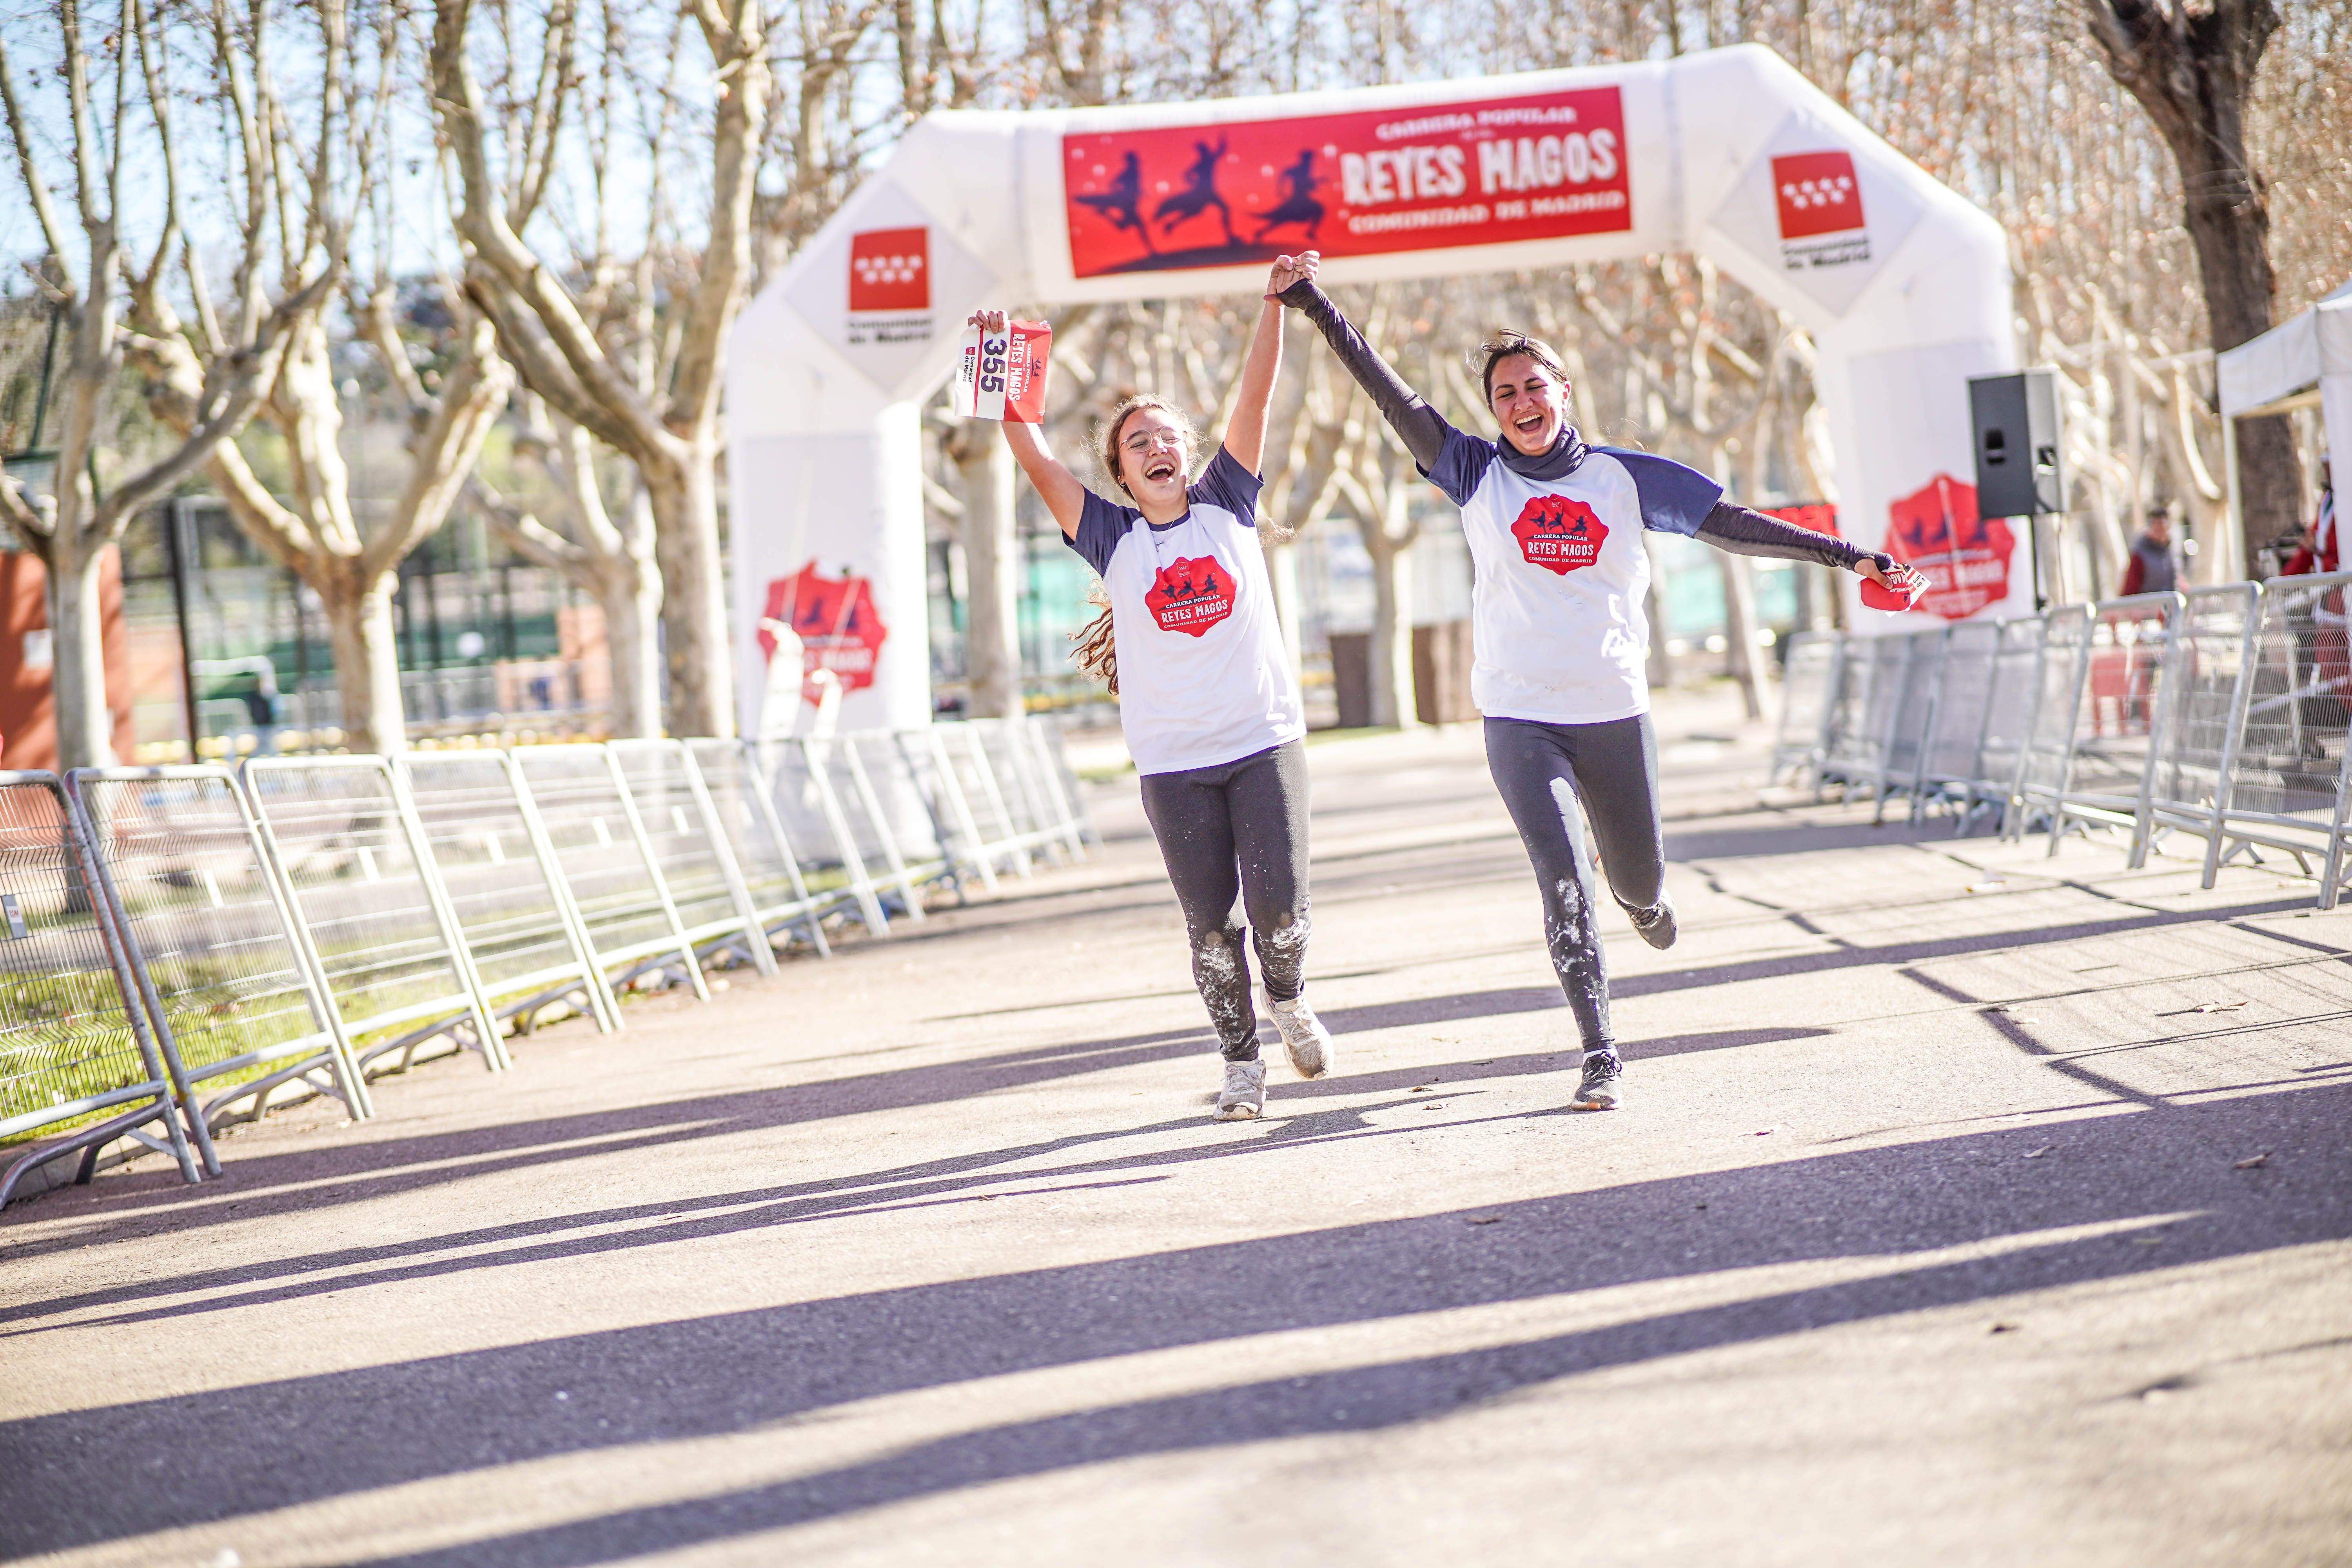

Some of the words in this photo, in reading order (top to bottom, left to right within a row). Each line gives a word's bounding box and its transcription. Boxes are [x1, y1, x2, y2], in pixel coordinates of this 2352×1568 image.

[1376, 113, 1473, 141] CARRERA
[1477, 107, 1577, 127] POPULAR
[1339, 145, 1467, 205] REYES
[1477, 128, 1617, 194] MAGOS
[1348, 205, 1490, 234] COMUNIDAD
[1495, 201, 1527, 220] DE
[1532, 191, 1625, 215] MADRID
[1011, 334, 1026, 363] REYES
[981, 339, 1007, 392] 355
[1008, 367, 1023, 401] MAGOS
[1528, 542, 1557, 555] REYES
[1561, 544, 1593, 556] MAGOS
[1161, 608, 1192, 623] REYES
[1195, 599, 1228, 617] MAGOS
[1166, 600, 1192, 608] CARRERA
[1194, 594, 1220, 603] POPULAR
[1163, 620, 1197, 628] COMUNIDAD
[1207, 612, 1228, 621] MADRID
